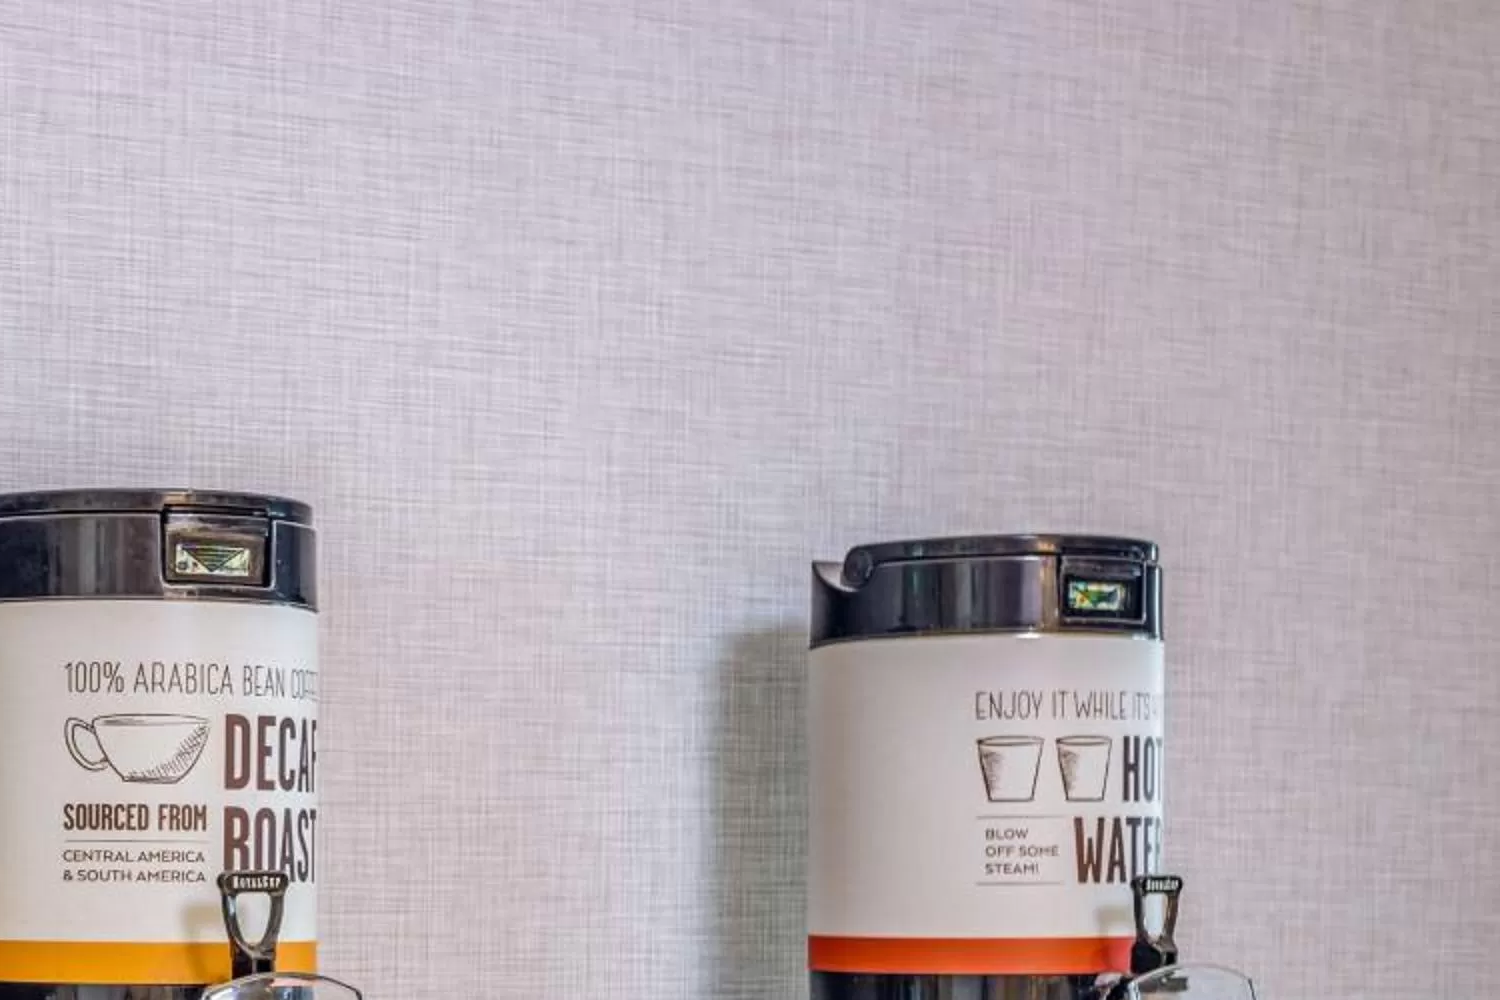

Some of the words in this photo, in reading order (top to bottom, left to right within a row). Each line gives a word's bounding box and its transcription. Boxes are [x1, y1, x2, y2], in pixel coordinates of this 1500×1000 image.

[65, 662, 124, 693] 100%
[133, 662, 233, 695] ARABICA
[243, 665, 285, 698] BEAN
[975, 691, 1042, 720] ENJOY
[1051, 691, 1070, 720] IT
[1074, 691, 1127, 720] WHILE
[63, 803, 149, 832] SOURCED
[158, 804, 207, 831] FROM
[985, 828, 1029, 841] BLOW
[224, 806, 316, 883] ROAST
[62, 850, 134, 863] CENTRAL
[137, 850, 205, 863] AMERICA
[985, 845, 1013, 858] OFF
[1018, 845, 1060, 858] SOME
[985, 863, 1040, 876] STEAM!
[63, 870, 73, 882] &
[77, 870, 132, 882] SOUTH
[135, 870, 206, 883] AMERICA
